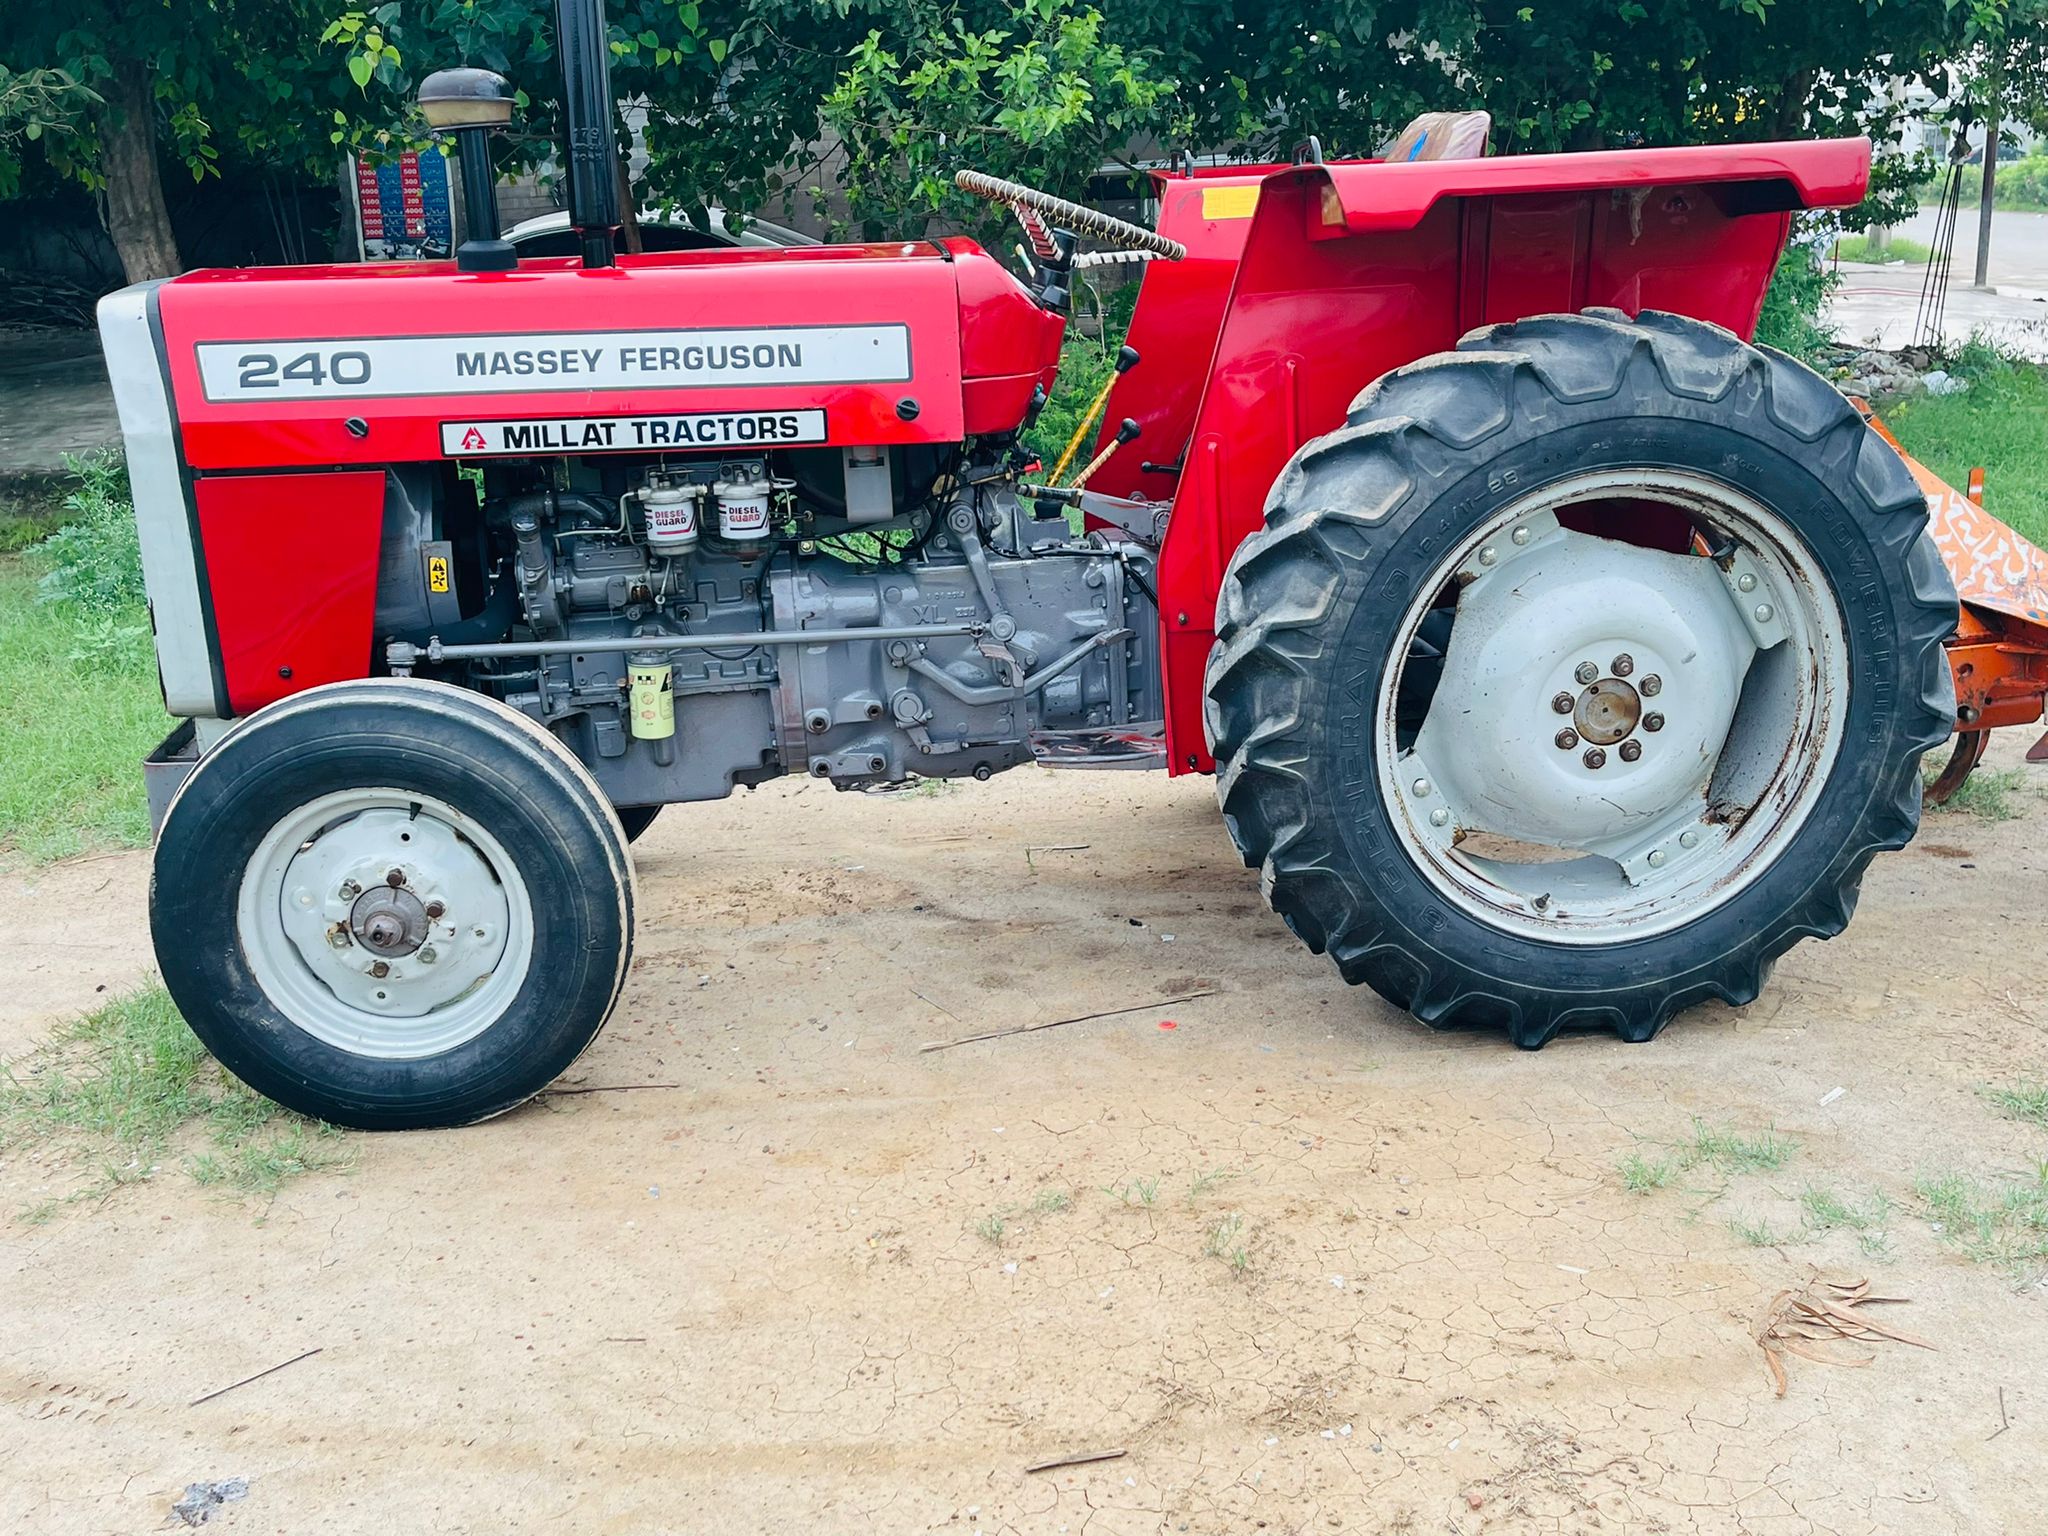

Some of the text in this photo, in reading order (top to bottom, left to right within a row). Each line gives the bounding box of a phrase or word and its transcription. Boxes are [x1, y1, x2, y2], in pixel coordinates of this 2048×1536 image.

[238, 351, 372, 388] 240
[456, 343, 803, 377] MASSEY FERGUSON
[503, 415, 799, 450] MILLAT TRACTORS
[655, 509, 687, 519] DIESEL
[728, 505, 760, 514] DIESEL
[913, 603, 948, 626] XL
[1808, 497, 1892, 744] POWER LUG
[1339, 630, 1408, 895] GENERAL
